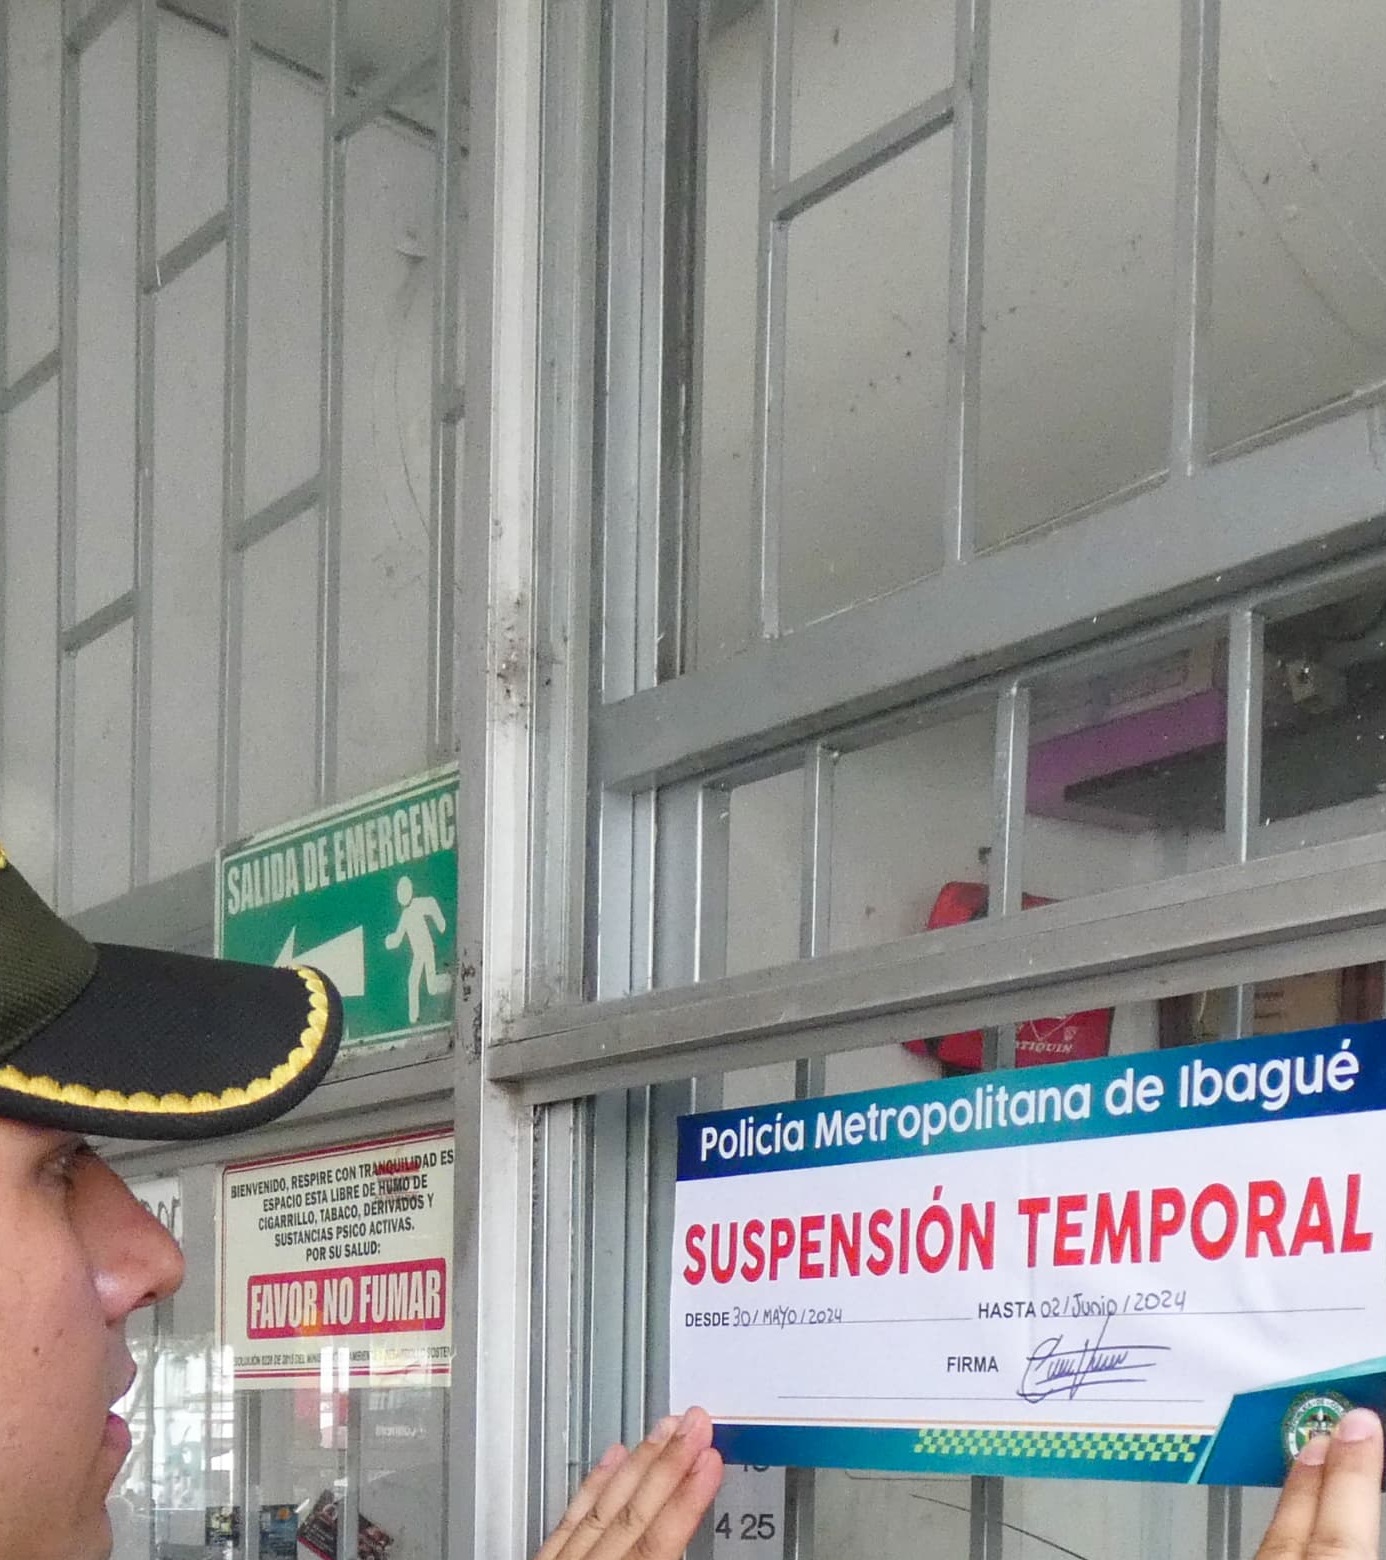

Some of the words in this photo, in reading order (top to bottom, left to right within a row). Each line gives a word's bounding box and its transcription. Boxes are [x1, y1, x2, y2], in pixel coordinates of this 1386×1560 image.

[227, 847, 299, 915] SALIDA
[303, 838, 330, 892] DE
[1016, 1040, 1073, 1053] TIQUIN
[700, 1110, 805, 1162] Policía
[813, 1081, 1092, 1148] Metropolitana
[1114, 1067, 1163, 1113] de
[1179, 1038, 1361, 1111] Ibagué
[231, 1177, 289, 1199] BIENVENIDO,
[291, 1171, 333, 1190] RESPIRE
[335, 1167, 356, 1184] CON
[359, 1153, 437, 1179] TRANQUILIDAD
[263, 1193, 303, 1212] ESPACIO
[305, 1190, 327, 1206] ESTA
[330, 1185, 359, 1203] LIBRE
[362, 1183, 376, 1198] DE
[378, 1177, 410, 1195] HUMO
[414, 1174, 428, 1190] DE
[320, 1204, 362, 1223] TABACO,
[364, 1195, 425, 1218] DERIVADOS
[427, 1193, 435, 1208] Y
[274, 1226, 333, 1248] SUSTANCIAS
[336, 1224, 366, 1241] PSICO
[369, 1216, 415, 1237] ACTIVAS.
[683, 1184, 998, 1287] SUSPENSIÓN
[1018, 1172, 1375, 1270] TEMPORAL
[306, 1246, 327, 1262] POR
[329, 1244, 342, 1259] SU
[344, 1240, 381, 1258] SALUD:
[250, 1280, 318, 1329] FAVOR
[322, 1276, 353, 1326] NO
[359, 1270, 442, 1323] FUMAR
[685, 1311, 730, 1328] DESDE
[978, 1301, 1036, 1319] HASTA
[947, 1355, 999, 1373] FIRMA
[740, 1513, 776, 1541] 25
